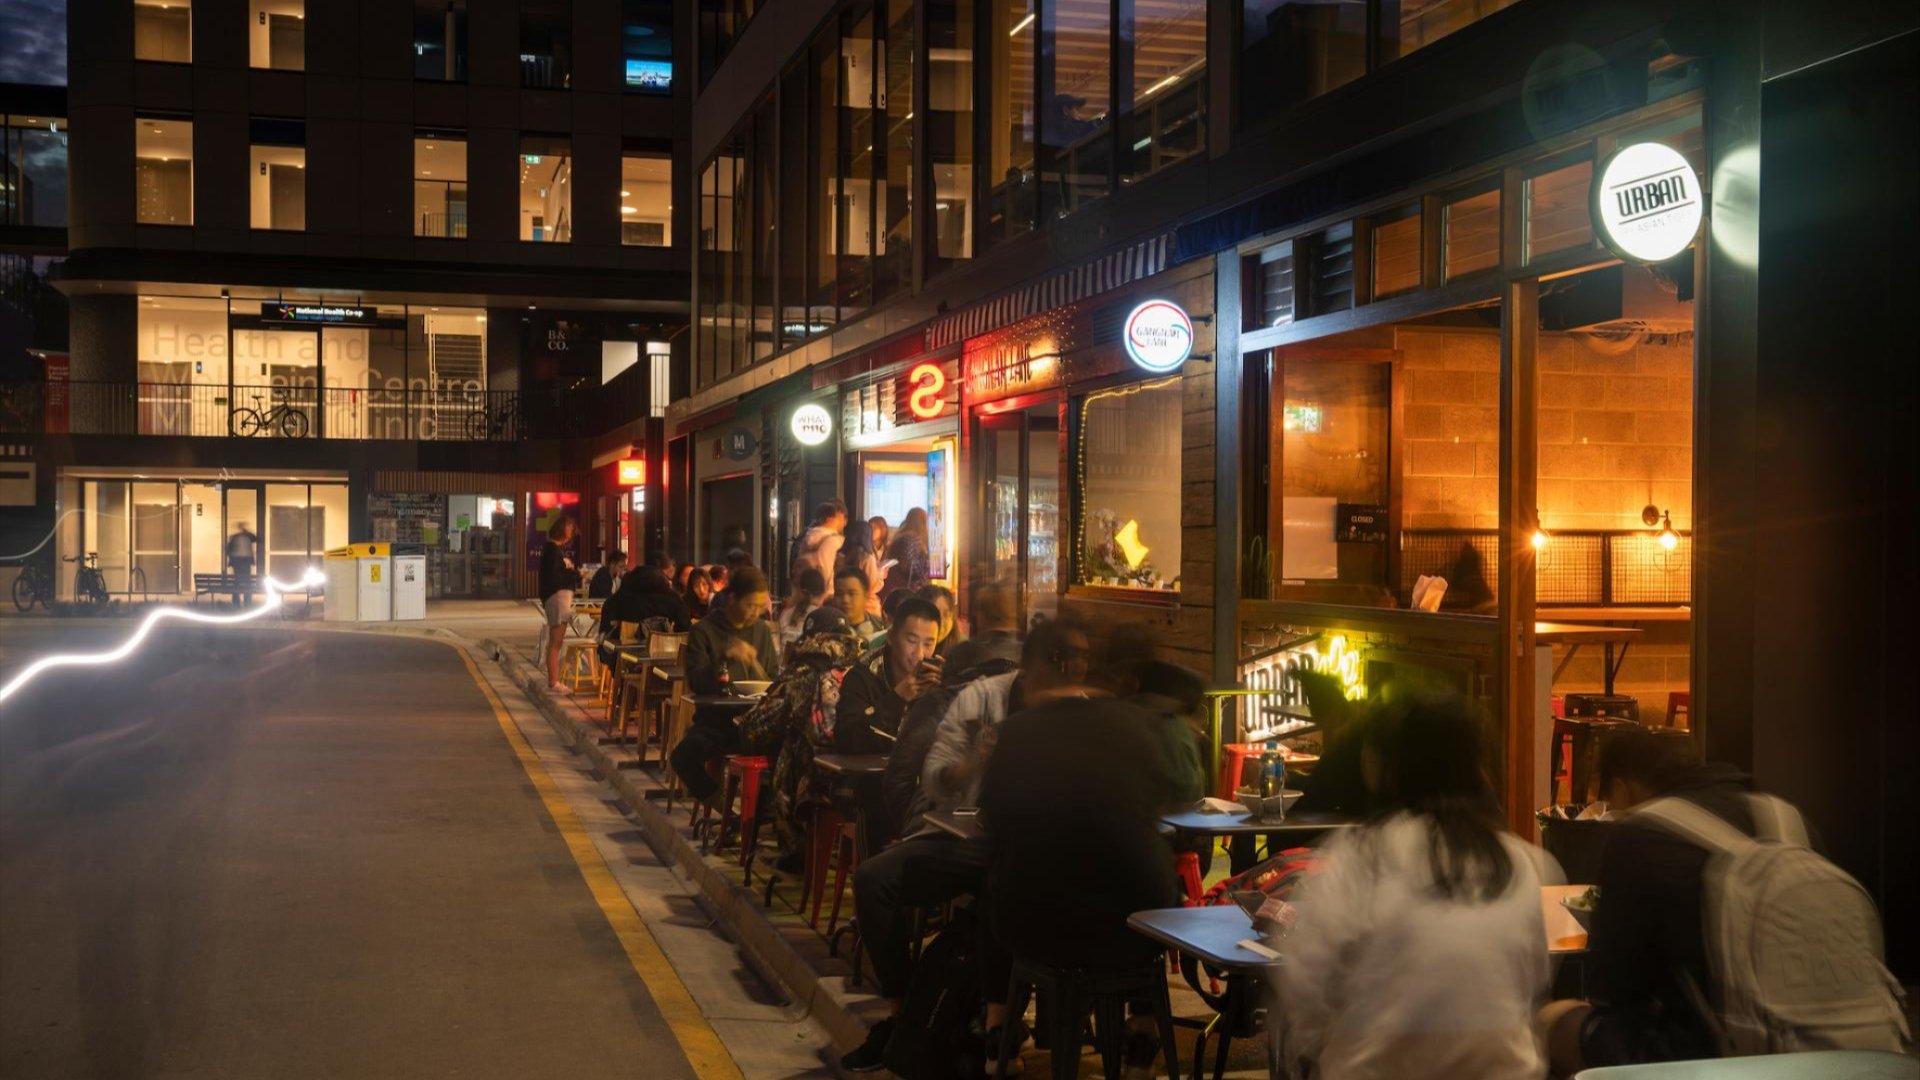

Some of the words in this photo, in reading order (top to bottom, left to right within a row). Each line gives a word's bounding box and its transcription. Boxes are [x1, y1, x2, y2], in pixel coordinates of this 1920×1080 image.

[1616, 175, 1687, 217] URBAN
[345, 309, 363, 317] Co-op
[153, 321, 284, 358] Health
[298, 329, 368, 361] and
[357, 367, 483, 403] Centre
[733, 434, 745, 450] M
[1351, 515, 1374, 523] CLOSED
